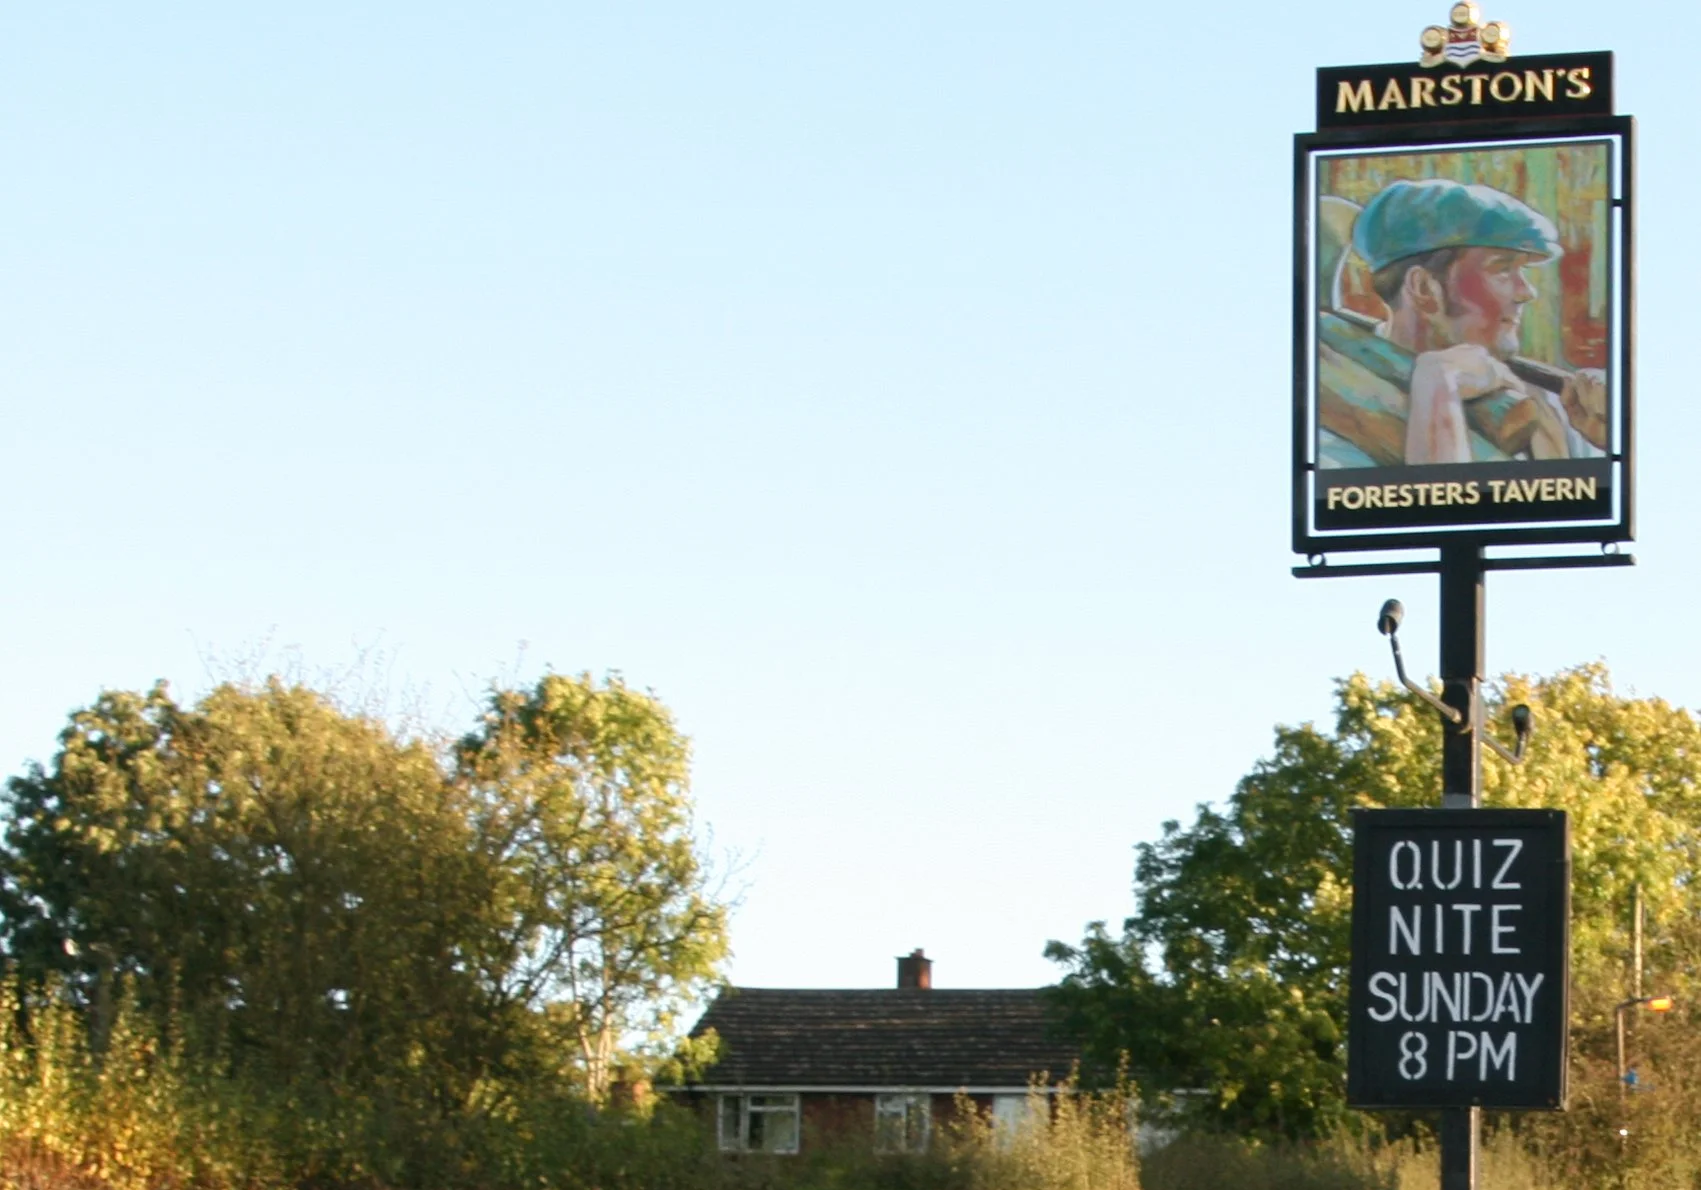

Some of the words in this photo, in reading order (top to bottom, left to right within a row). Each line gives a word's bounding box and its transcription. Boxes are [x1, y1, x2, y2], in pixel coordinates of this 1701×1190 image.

[1335, 67, 1591, 113] MARSTON'S
[1327, 482, 1480, 510] FORESTERS
[1487, 476, 1597, 504] TAVERN
[1389, 839, 1523, 890] QUIZ
[1389, 904, 1522, 955] NITE
[1367, 971, 1544, 1023] SUNDAY
[1399, 1031, 1427, 1080] 8
[1447, 1031, 1517, 1081] PM
